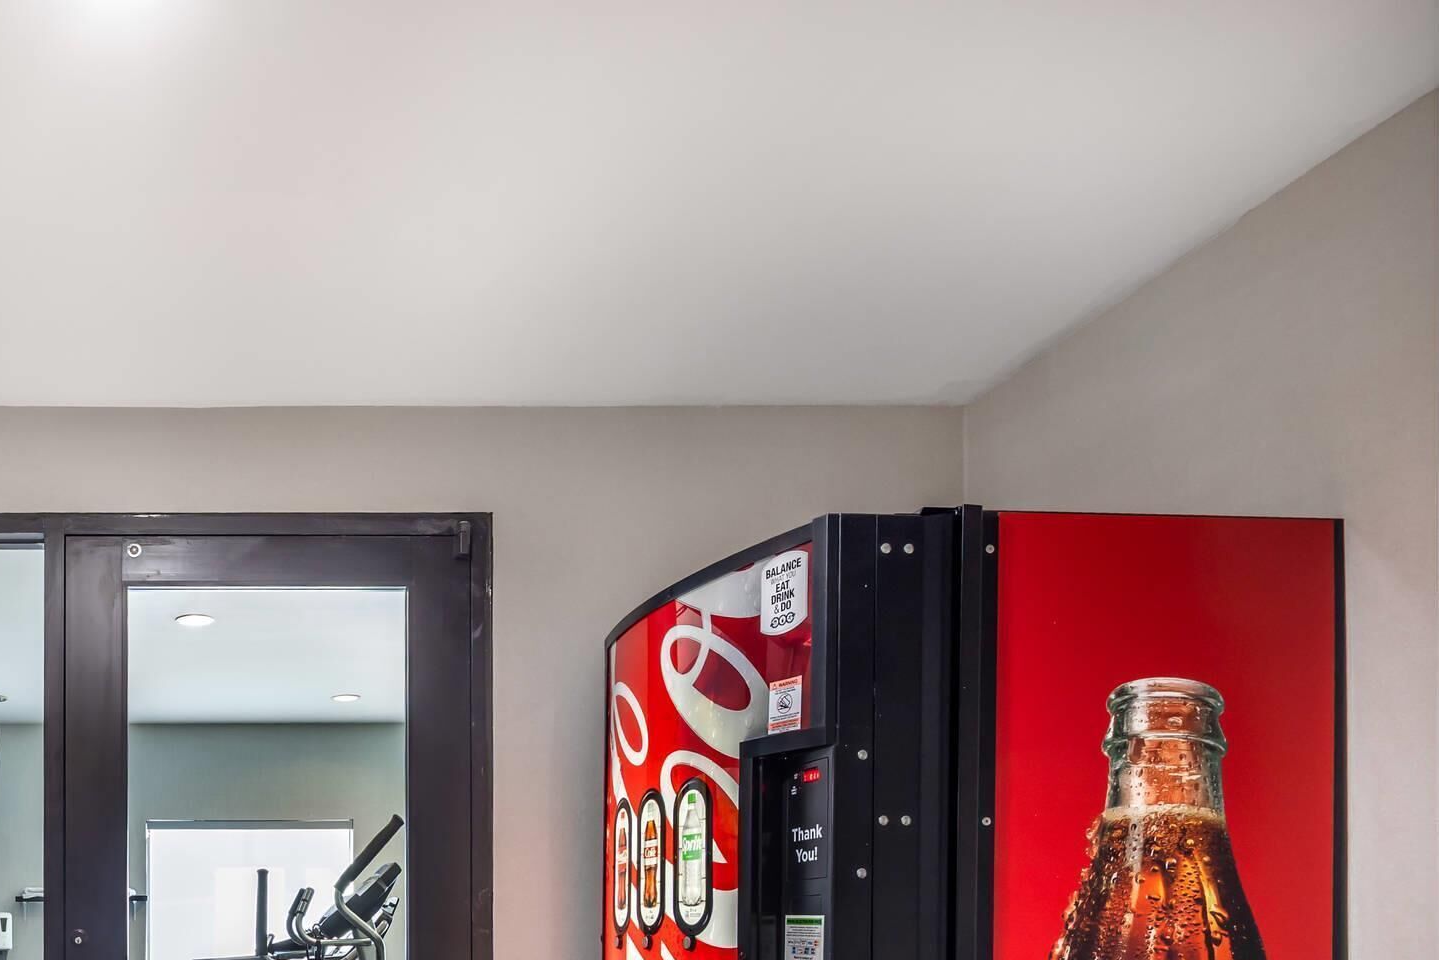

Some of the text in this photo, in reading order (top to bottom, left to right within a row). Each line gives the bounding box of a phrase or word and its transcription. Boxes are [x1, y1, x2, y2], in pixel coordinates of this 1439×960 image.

[765, 556, 802, 580] BALANCE
[770, 569, 797, 585] WHAT YOU
[775, 579, 791, 593] EAT
[770, 587, 795, 606] DRINK
[773, 599, 792, 615] & DO
[791, 823, 823, 842] Thank
[795, 846, 818, 864] You!
